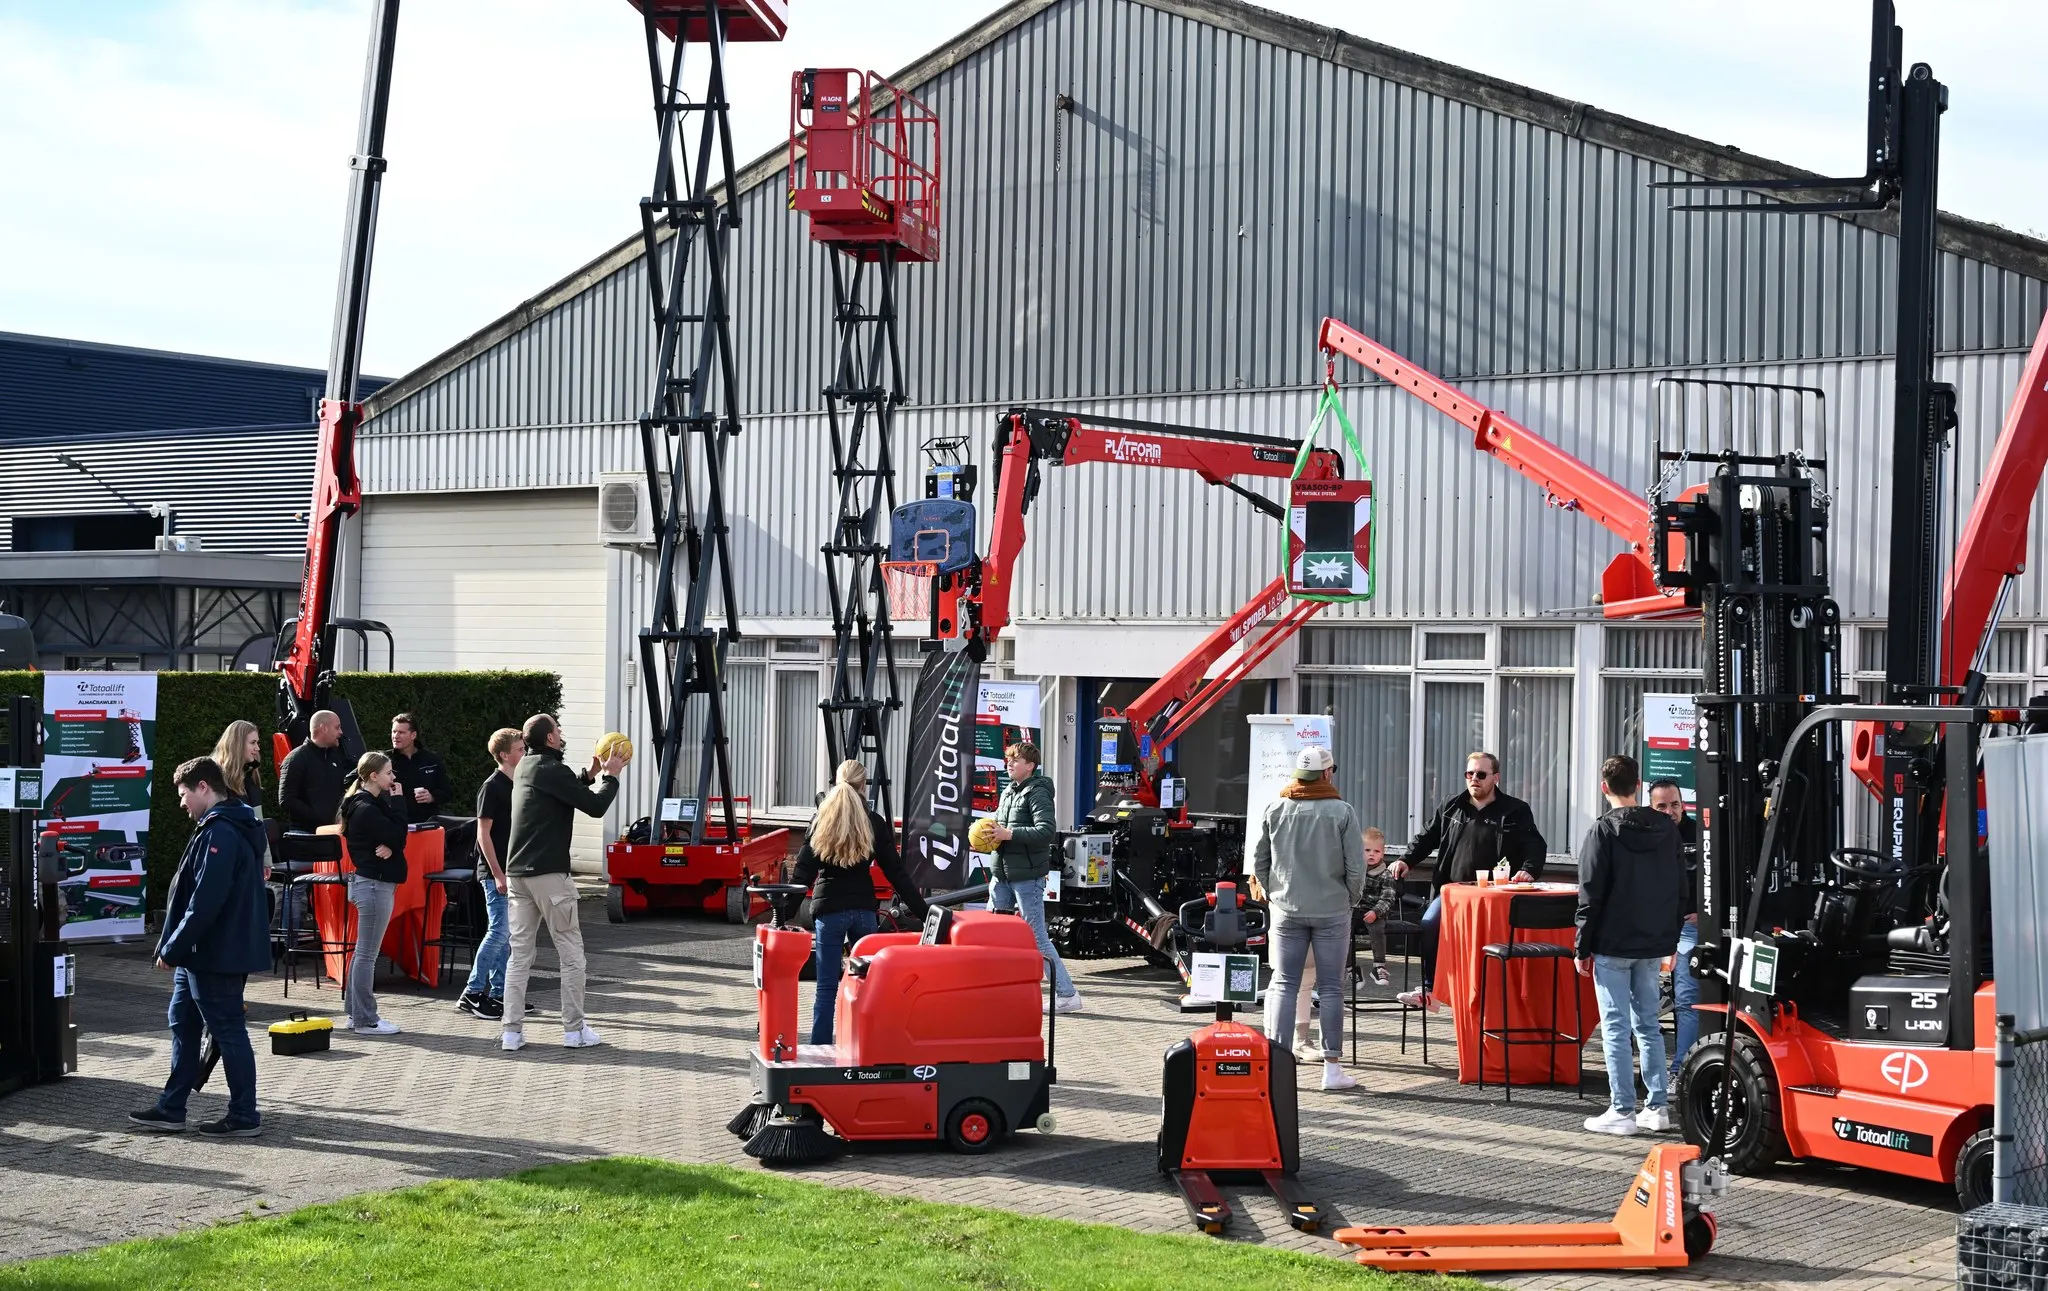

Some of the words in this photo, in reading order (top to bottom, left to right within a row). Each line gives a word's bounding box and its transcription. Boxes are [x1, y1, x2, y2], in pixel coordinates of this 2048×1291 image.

[1242, 604, 1267, 635] SPIDER
[1268, 589, 1285, 613] 18.90
[90, 684, 125, 692] Totaallift
[990, 692, 1016, 700] Totaallift
[988, 704, 1008, 712] MAGNI
[1066, 715, 1075, 723] 16
[1893, 773, 1904, 794] EP
[1703, 807, 1710, 828] EP
[1703, 830, 1712, 916] EQUIPMENT
[1911, 992, 1938, 1009] 25
[913, 1065, 937, 1081] EP
[1880, 1051, 1929, 1094] EP
[1855, 1125, 1910, 1150] Totaallift
[1664, 1170, 1675, 1228] DOOSAN
